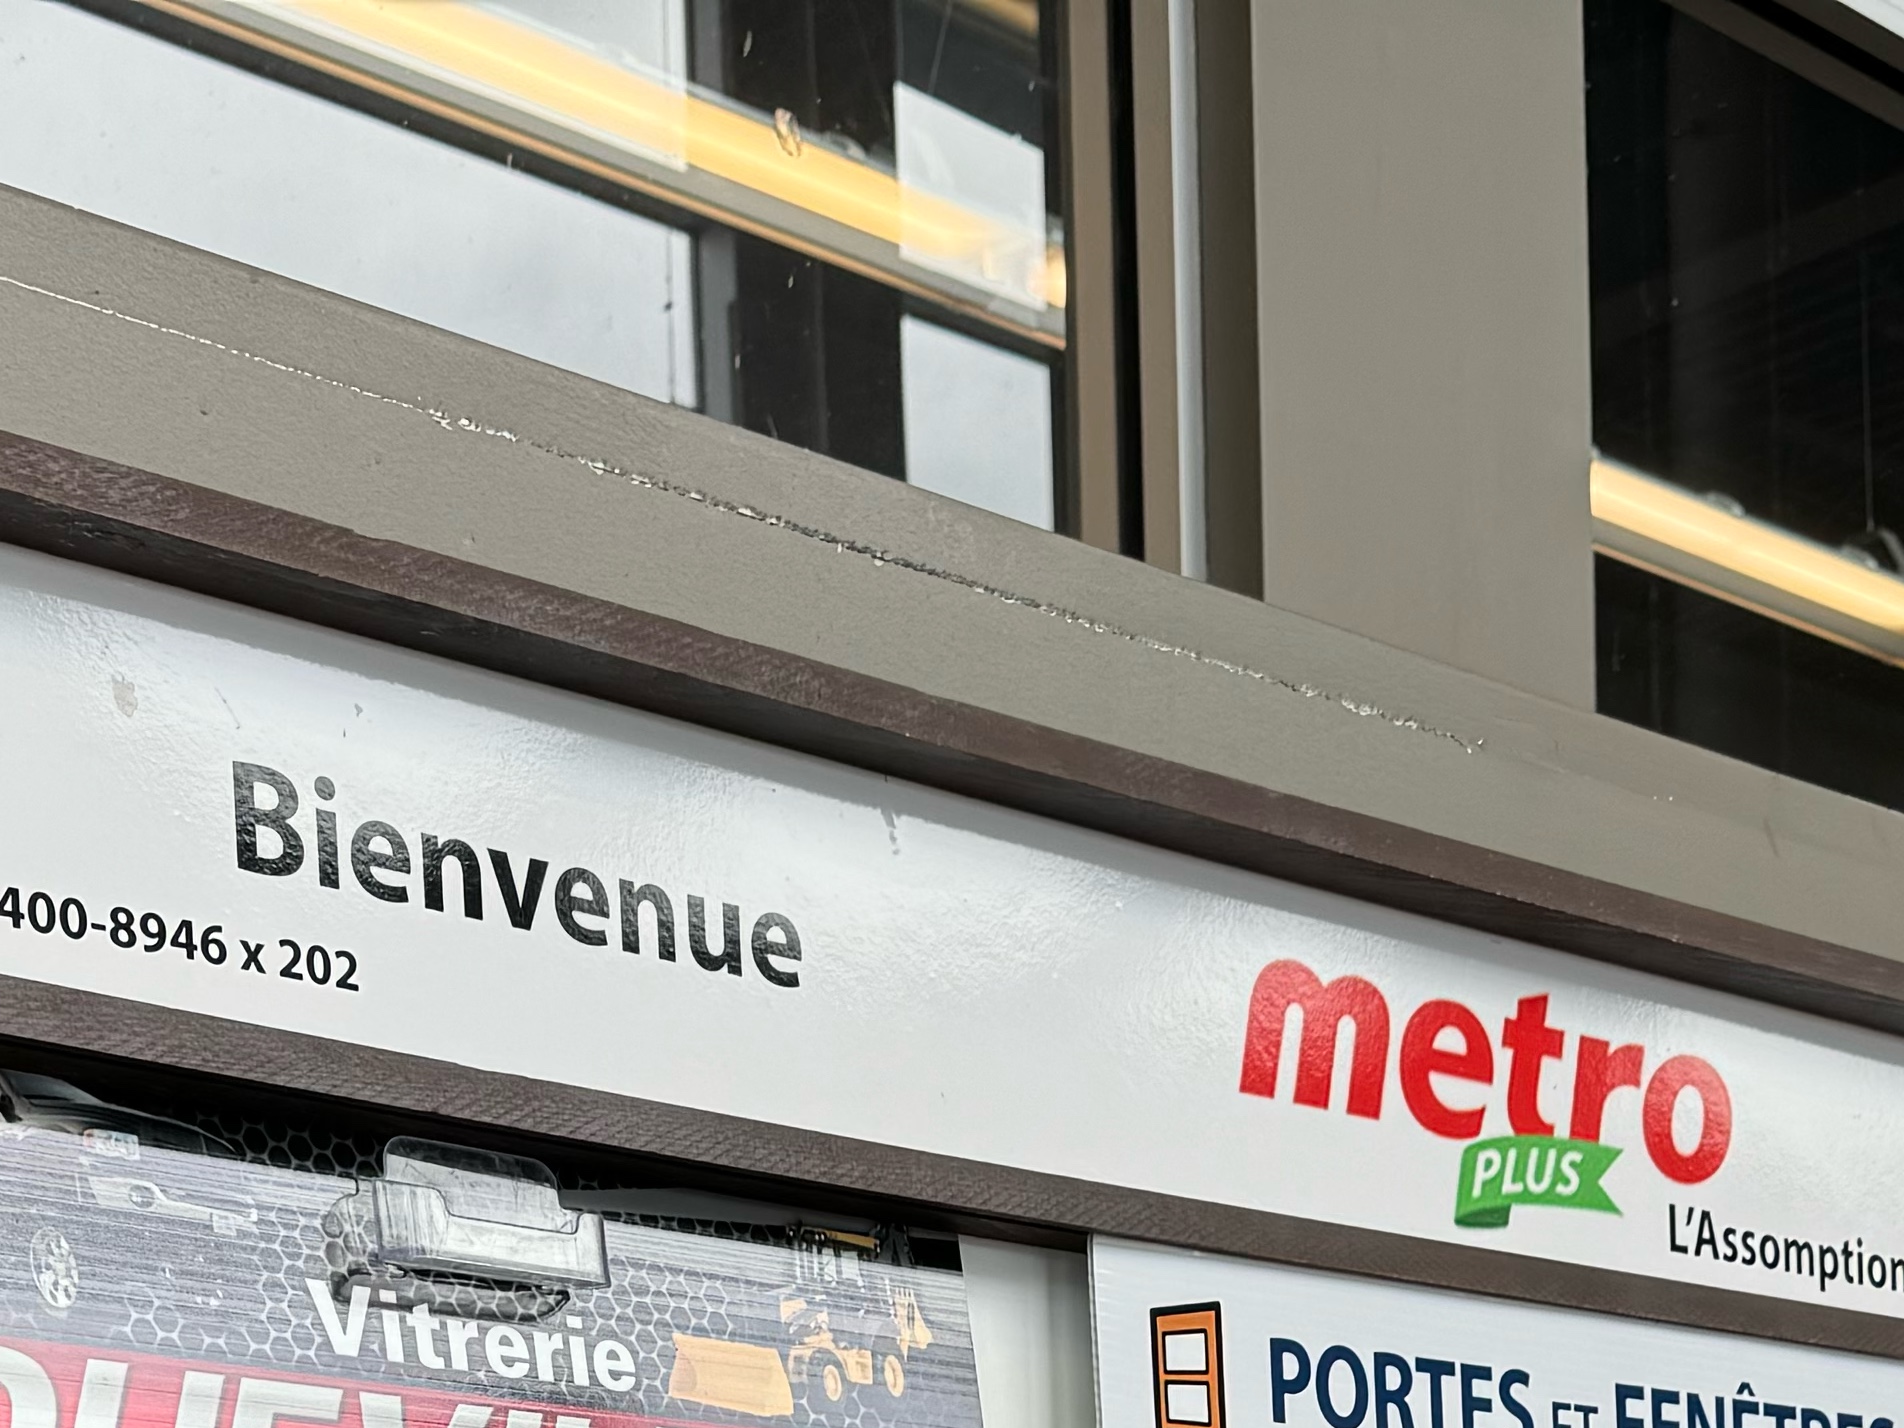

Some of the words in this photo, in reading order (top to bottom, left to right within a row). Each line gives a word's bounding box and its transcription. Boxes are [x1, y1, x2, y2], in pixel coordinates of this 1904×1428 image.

[232, 759, 803, 988] Bienvenue
[240, 941, 266, 975] x
[278, 938, 360, 993] 202
[1239, 958, 1733, 1185] metro
[1471, 1147, 1584, 1200] PLUS
[304, 1279, 637, 1393] Vitrerie
